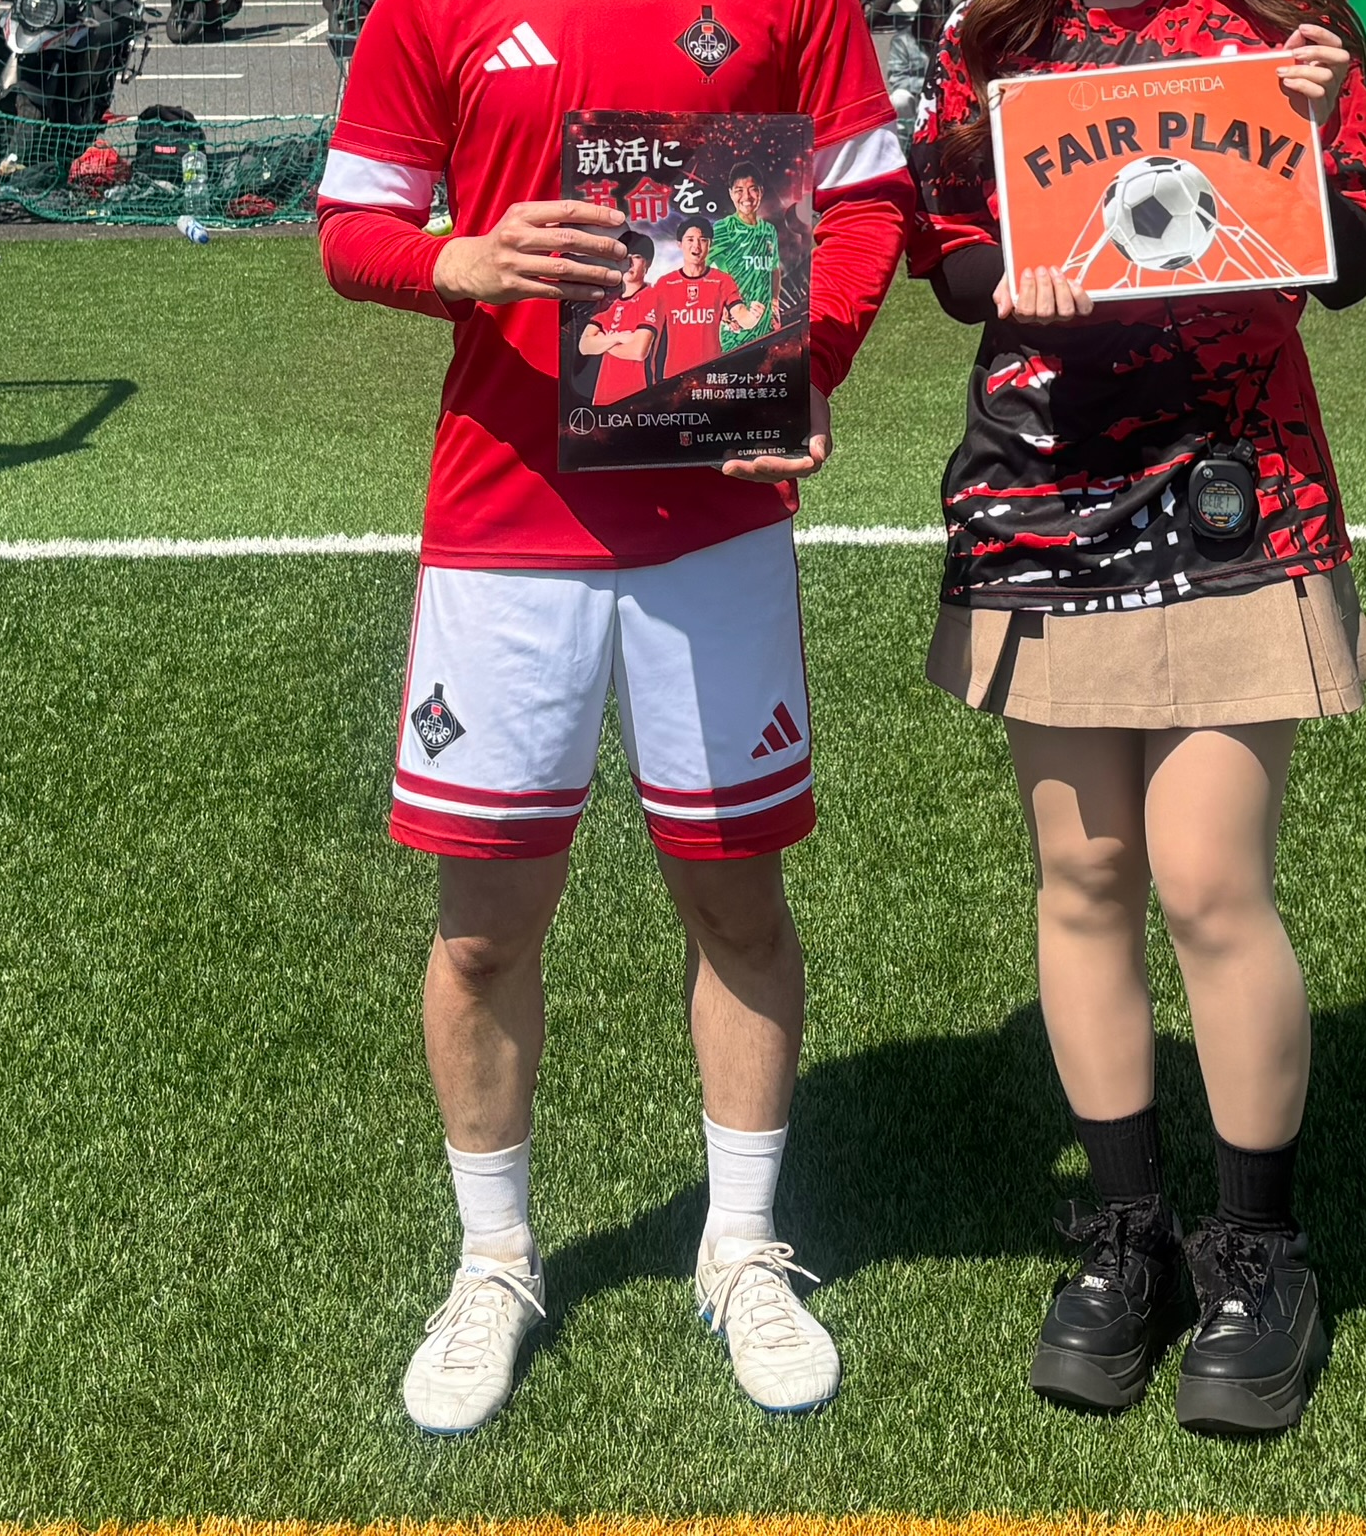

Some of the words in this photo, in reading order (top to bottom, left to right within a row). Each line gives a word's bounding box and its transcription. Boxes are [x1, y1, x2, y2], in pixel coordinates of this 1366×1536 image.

[690, 41, 726, 61] COPERIO
[576, 137, 683, 175] 就活に
[1023, 116, 1143, 189] FAIR
[1158, 111, 1306, 180] PLAY!
[671, 308, 715, 325] POLUS
[706, 372, 787, 384] 就活フットサルで
[691, 388, 788, 400] 採用の常識を変える
[696, 432, 742, 443] URAWA
[746, 430, 781, 440] REDS
